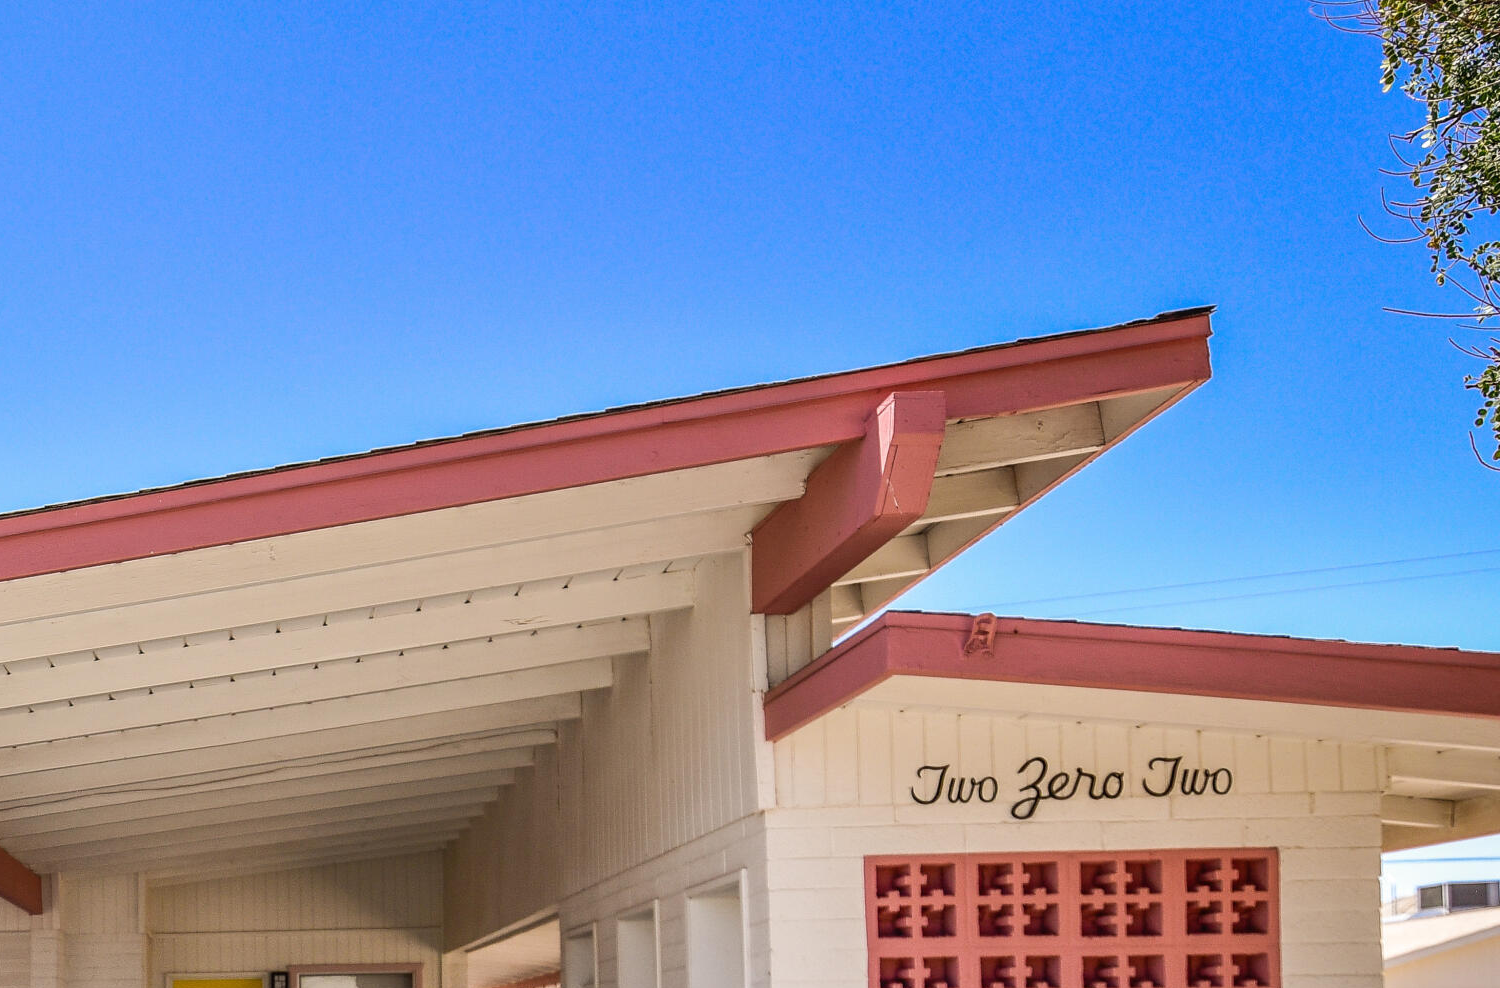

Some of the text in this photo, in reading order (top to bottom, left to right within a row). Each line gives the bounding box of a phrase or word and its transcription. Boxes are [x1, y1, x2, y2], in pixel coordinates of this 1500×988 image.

[910, 756, 1234, 820] Two Zero Two
